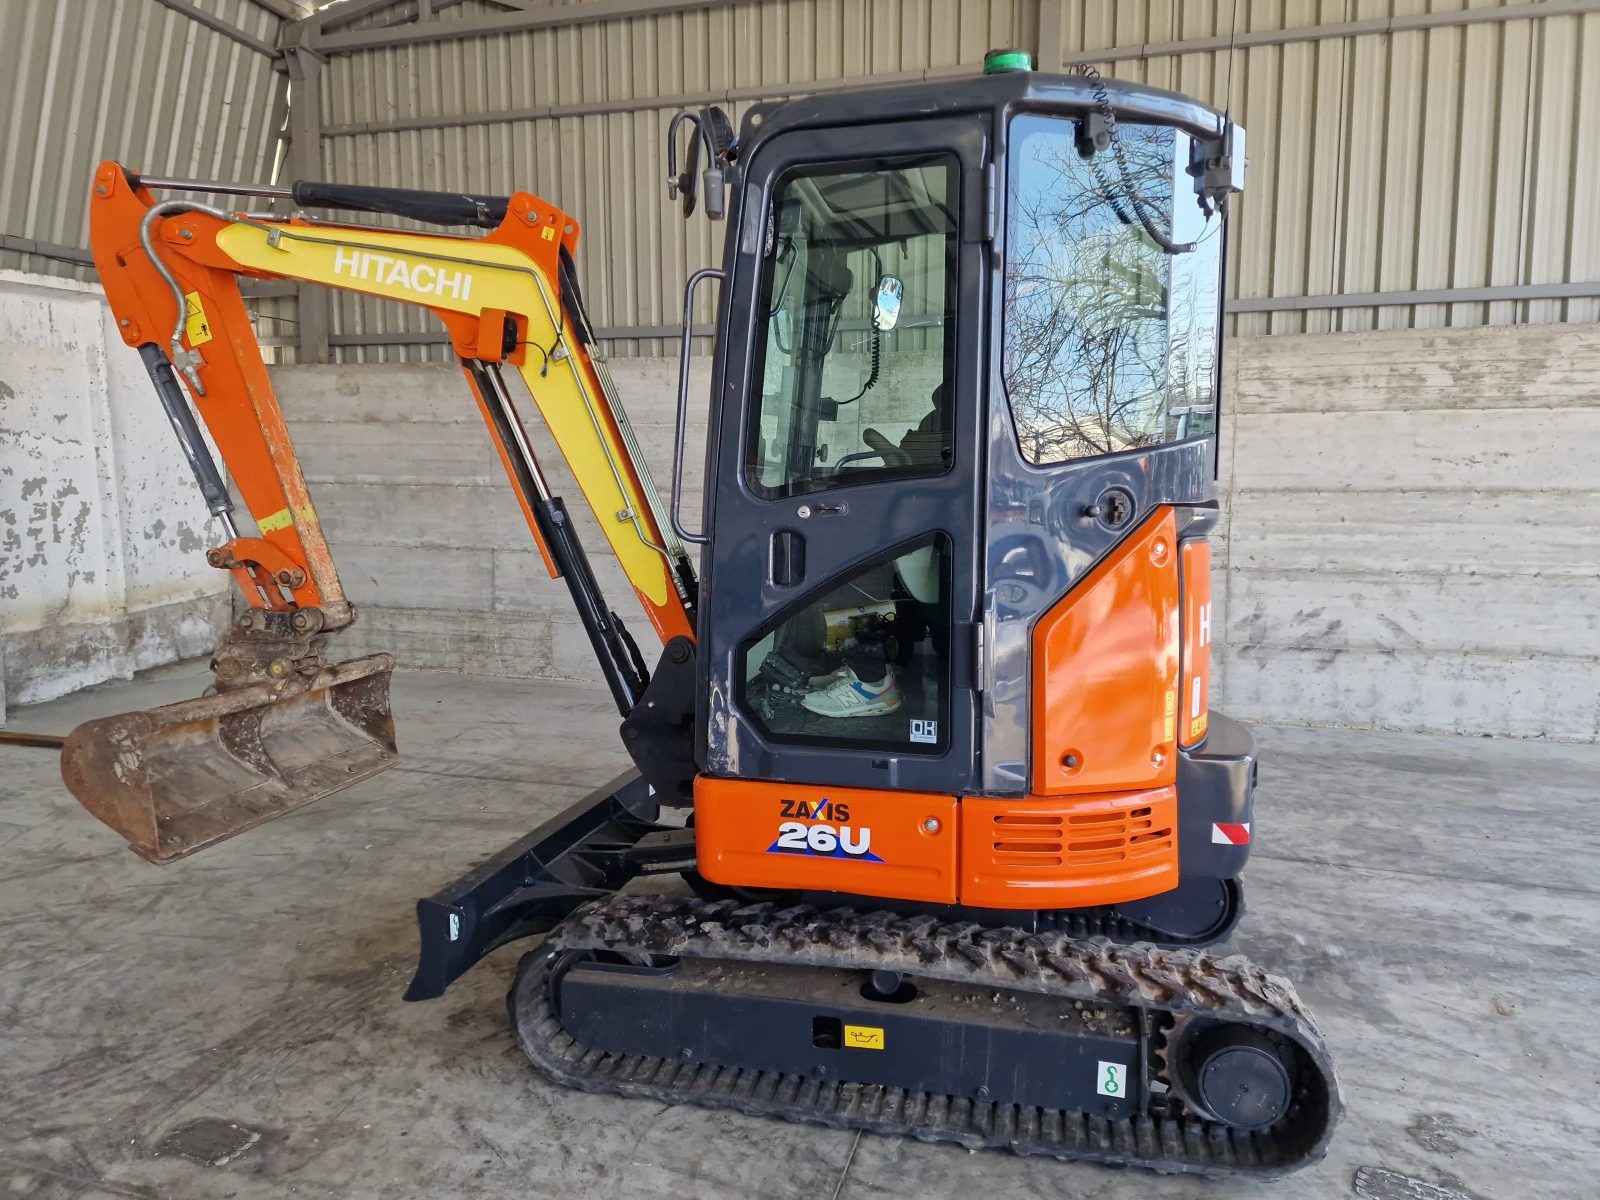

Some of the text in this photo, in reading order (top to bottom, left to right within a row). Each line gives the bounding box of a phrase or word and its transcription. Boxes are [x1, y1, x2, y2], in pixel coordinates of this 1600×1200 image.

[333, 247, 472, 301] HITACHI
[780, 798, 850, 822] ZAXIS
[777, 821, 871, 857] 26U
